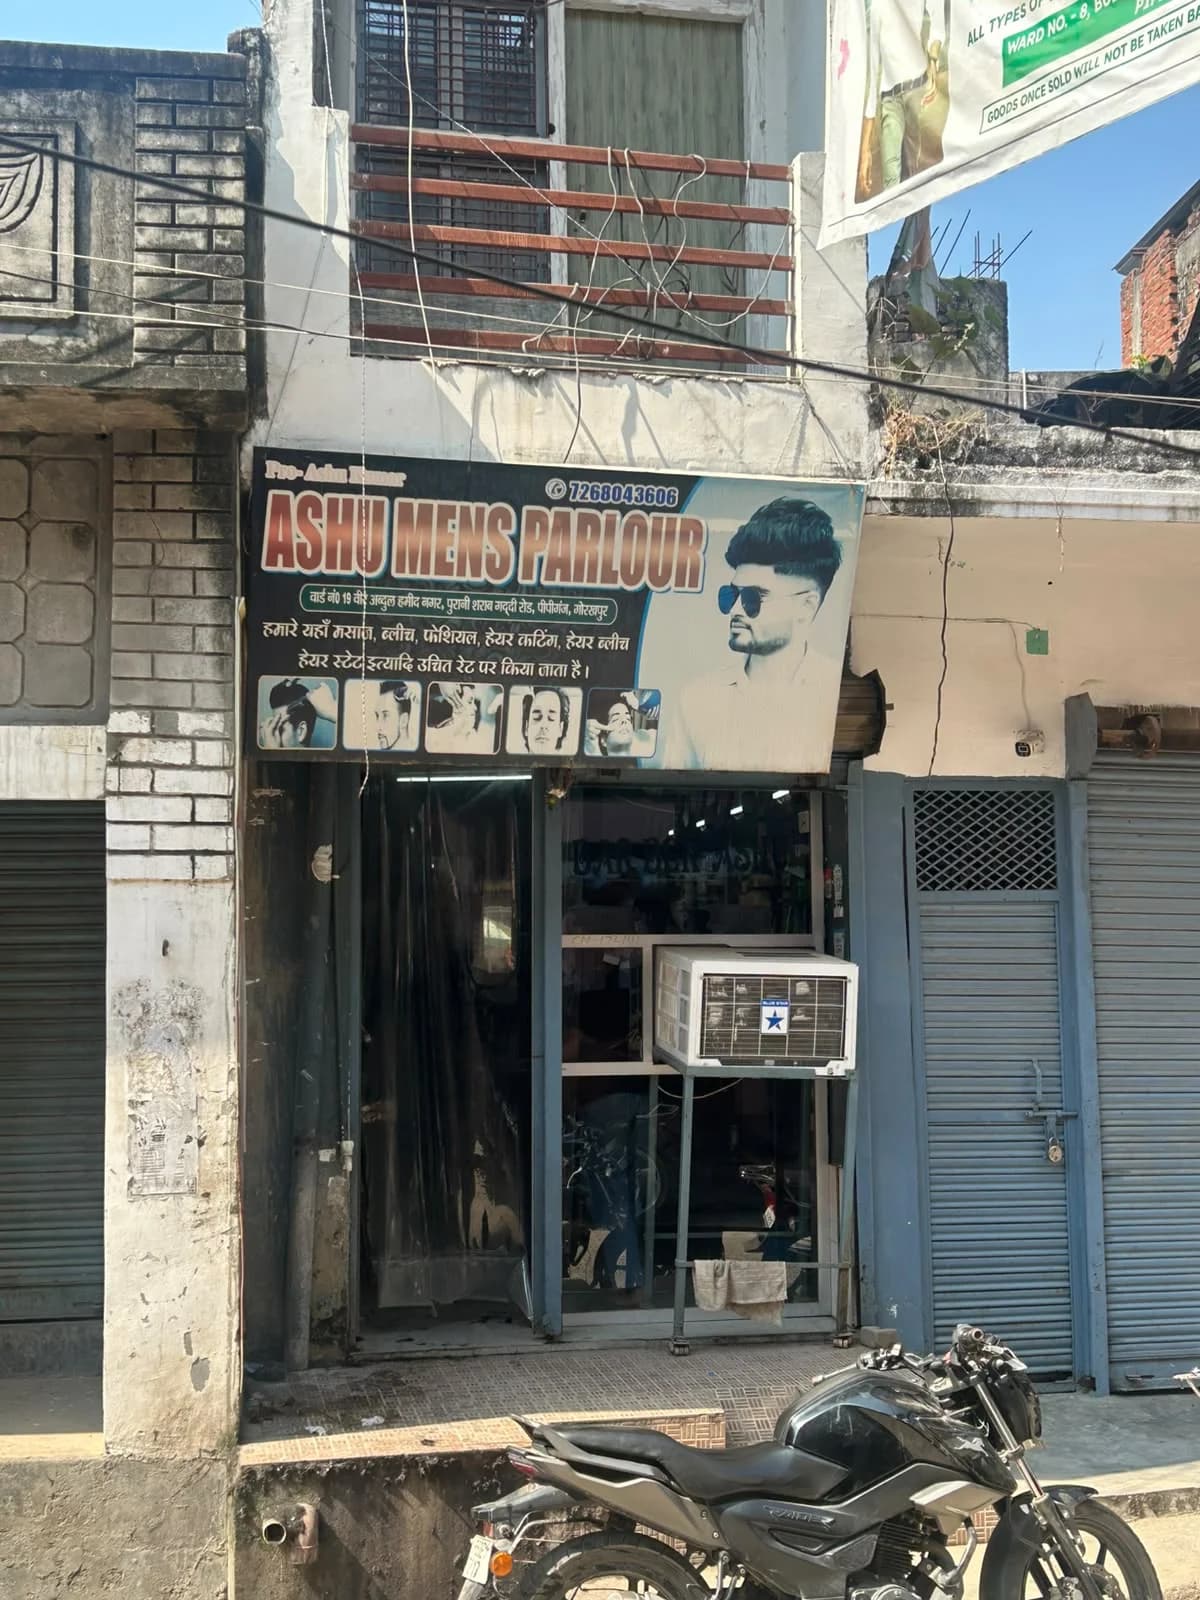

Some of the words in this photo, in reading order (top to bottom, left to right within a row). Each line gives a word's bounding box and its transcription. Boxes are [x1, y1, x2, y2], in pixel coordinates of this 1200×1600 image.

[967, 25, 984, 47] ALL
[990, 4, 1026, 32] TYPES
[1007, 27, 1044, 55] WARD
[1047, 14, 1067, 37] NO.
[1080, 4, 1090, 20] 8,
[987, 98, 1018, 123] GOODS
[1020, 84, 1046, 106] ONCE
[1048, 70, 1072, 93] SOLD
[1074, 56, 1099, 79] WILL
[1104, 43, 1127, 64] NOT
[1130, 35, 1144, 52] BE
[1147, 14, 1184, 43] TAKEN
[569, 480, 678, 507] 7268043606
[261, 489, 390, 577] ASHU
[391, 497, 518, 585] MENS
[518, 505, 707, 593] PARLOUR
[342, 591, 351, 604] 19
[262, 618, 298, 638] हमारे
[302, 618, 330, 639] यहाँ
[381, 623, 418, 645] ब्लीच,
[485, 627, 514, 647] हेयर
[517, 628, 561, 650] कटिंग,
[566, 630, 594, 650] हेयर
[598, 632, 630, 651] ब्लीच
[298, 648, 329, 669] हेयर
[417, 653, 452, 673] उचित
[456, 656, 475, 674] रेट
[479, 660, 497, 675] पर
[500, 657, 534, 677] किया
[538, 662, 567, 678] जाता
